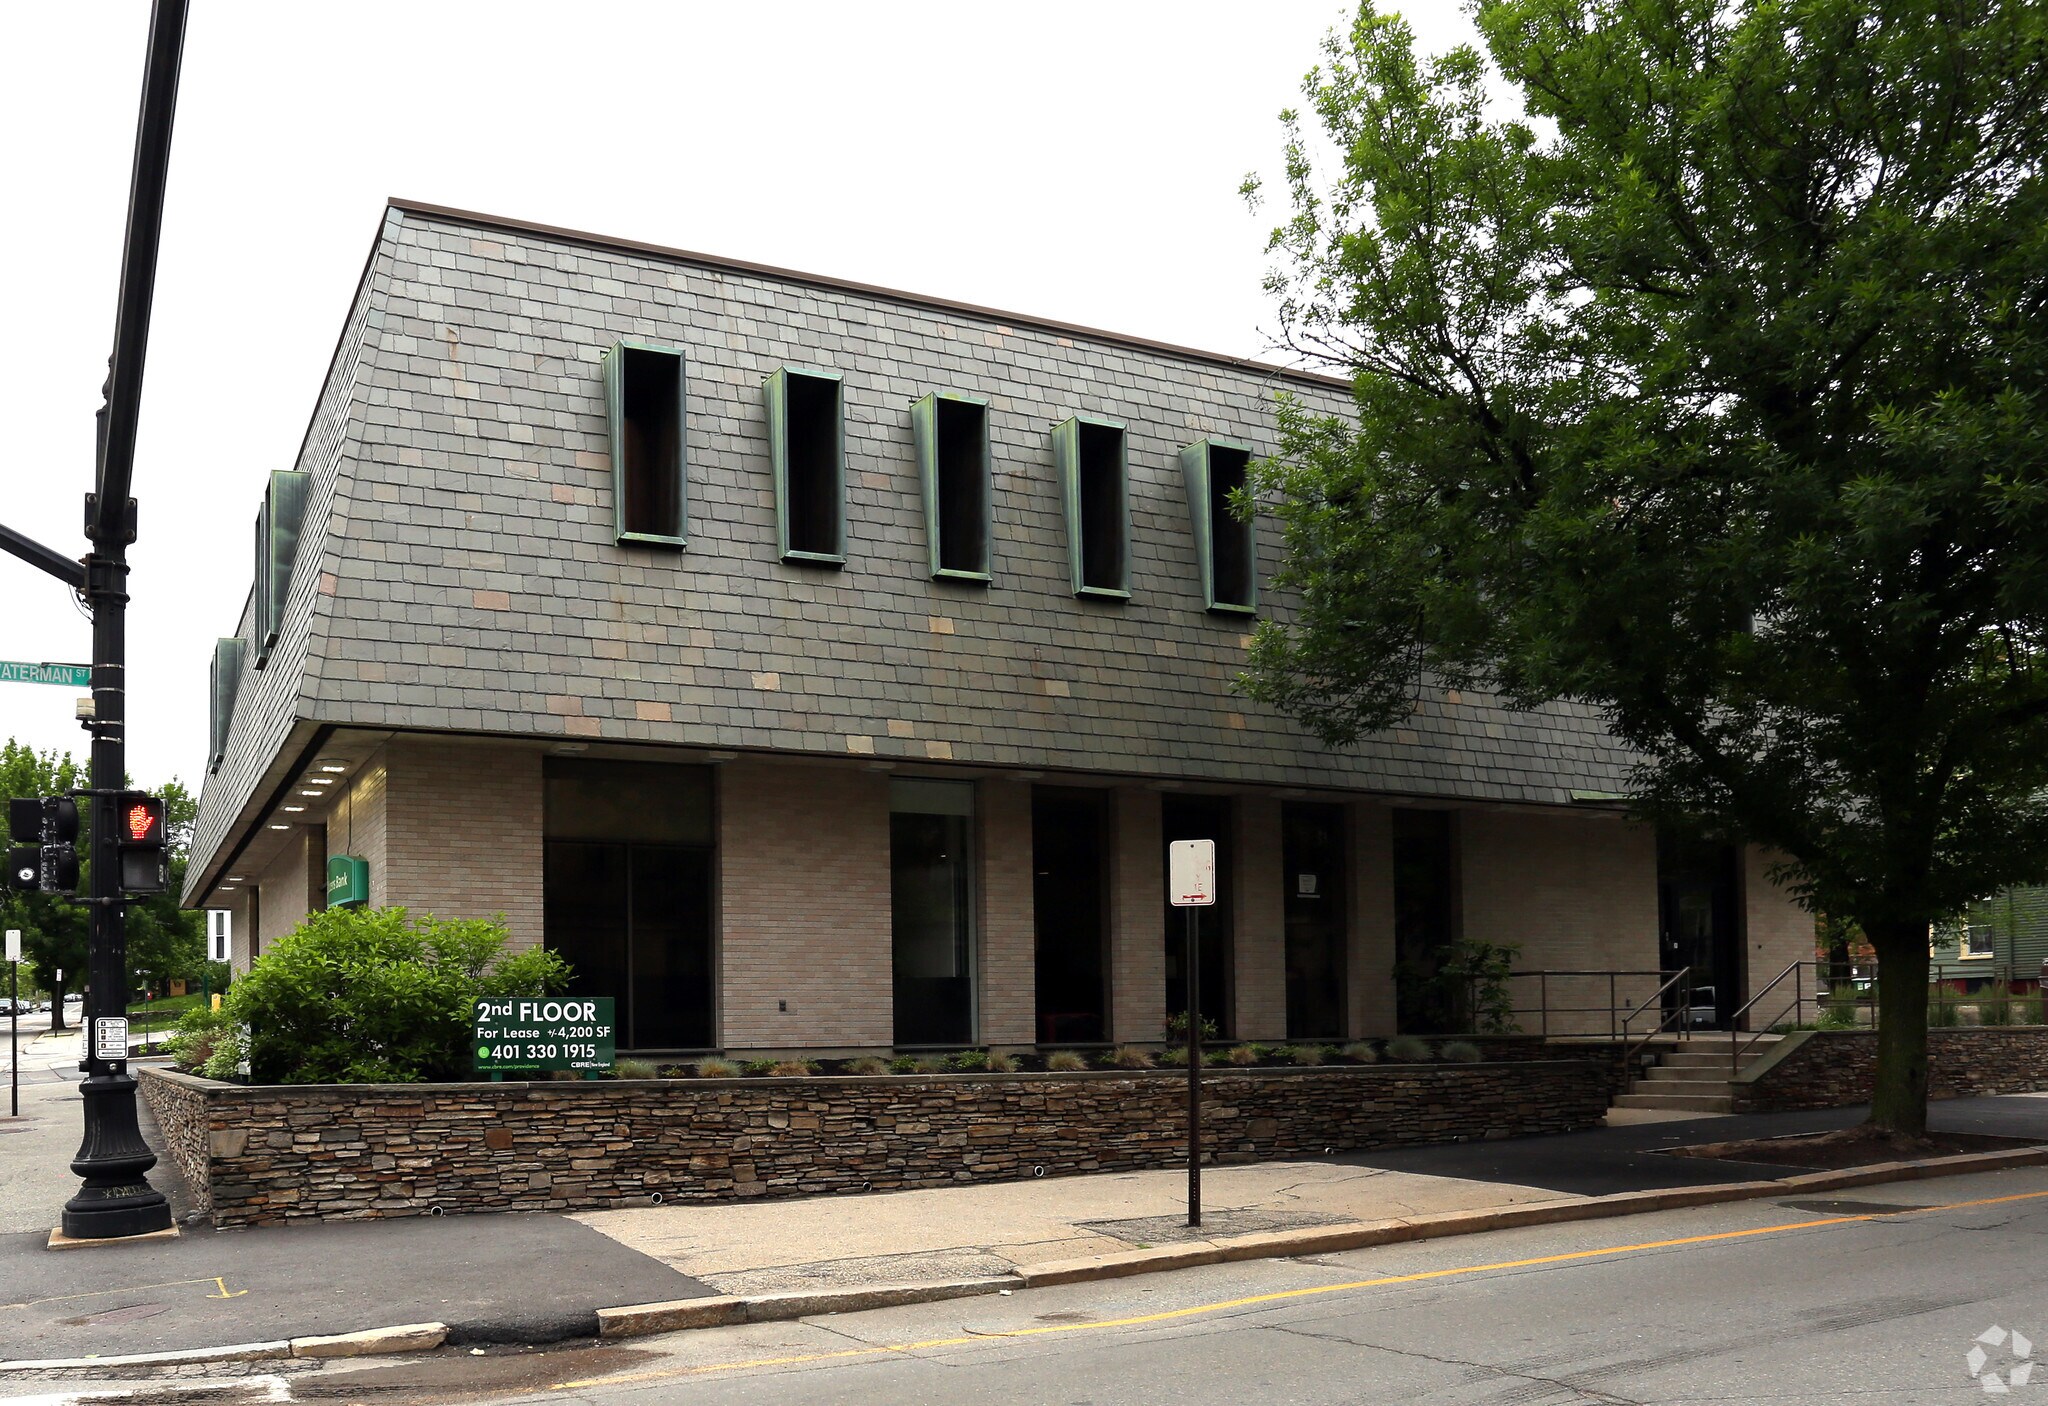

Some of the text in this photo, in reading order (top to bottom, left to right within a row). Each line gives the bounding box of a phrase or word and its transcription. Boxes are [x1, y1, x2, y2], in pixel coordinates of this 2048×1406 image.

[0, 664, 86, 683] ATERMAN ST
[477, 1000, 596, 1022] 2nd FLOOR
[477, 1027, 498, 1039] For
[503, 1027, 540, 1039] Lease
[596, 1026, 611, 1038] SF
[491, 1044, 596, 1059] 401 330 1915
